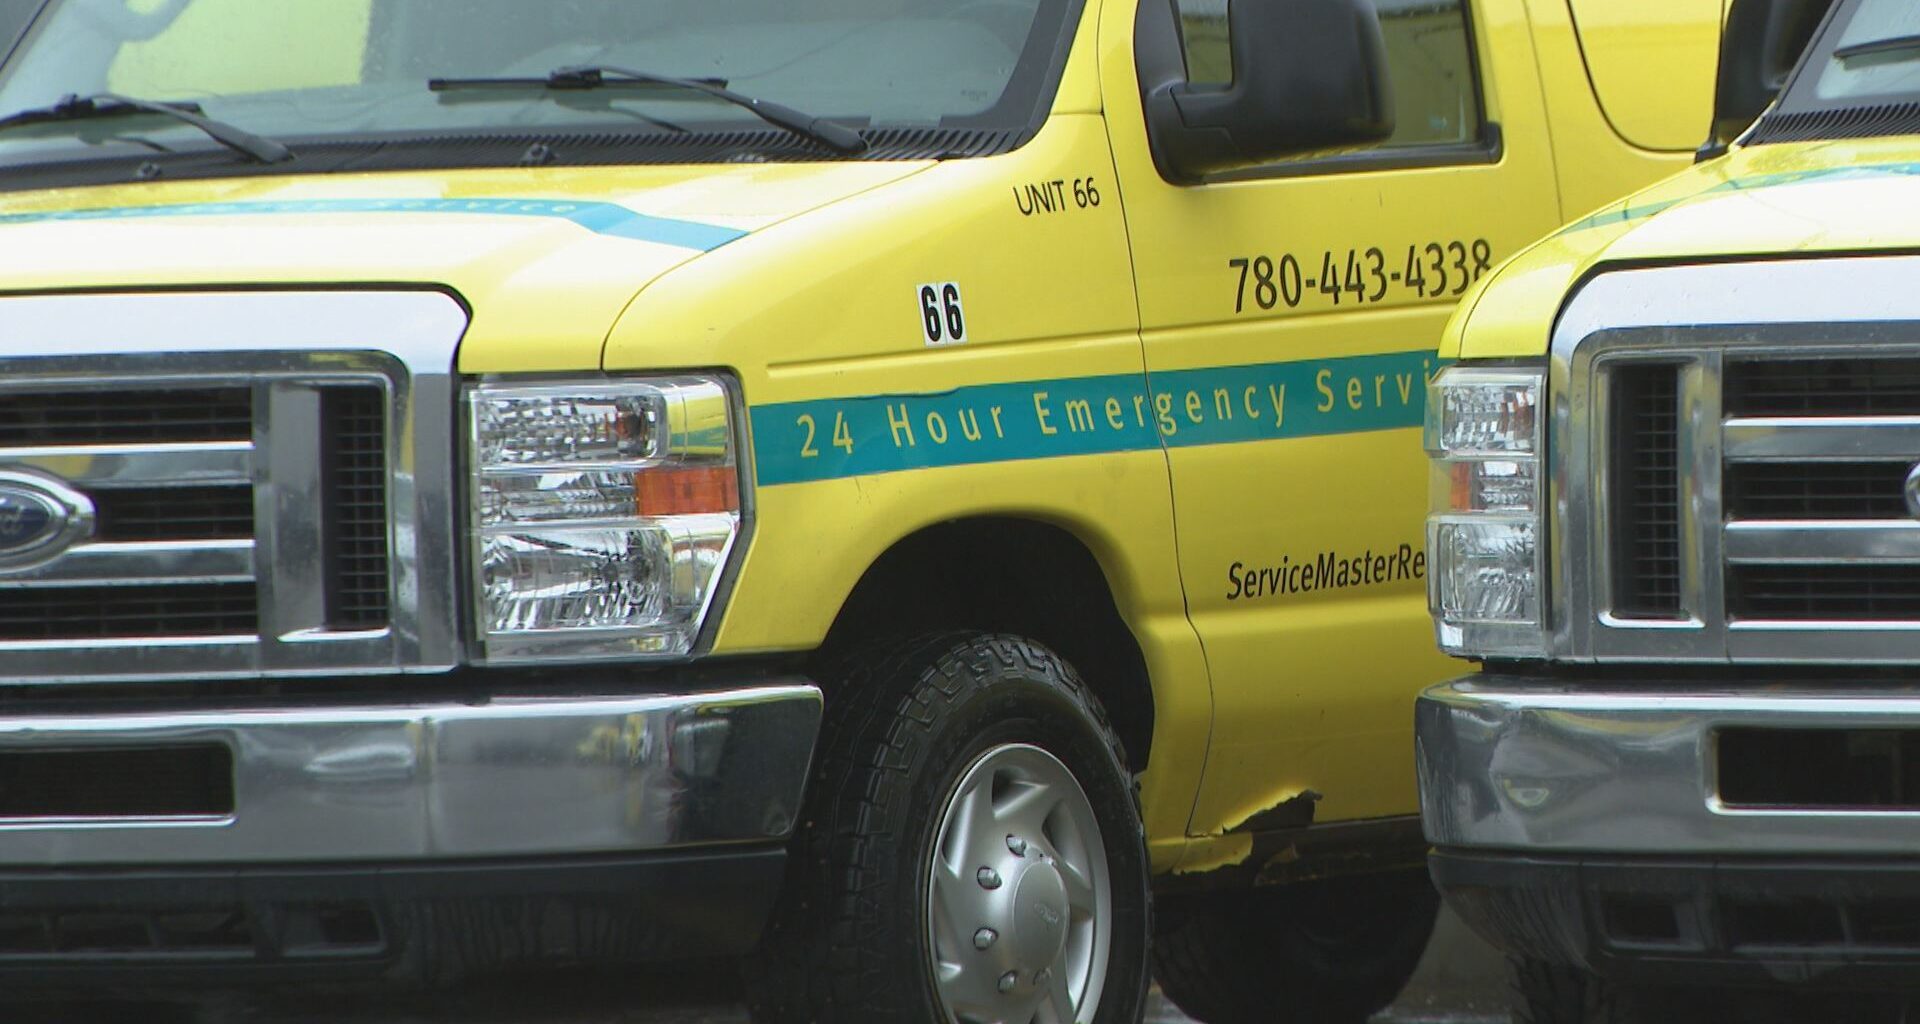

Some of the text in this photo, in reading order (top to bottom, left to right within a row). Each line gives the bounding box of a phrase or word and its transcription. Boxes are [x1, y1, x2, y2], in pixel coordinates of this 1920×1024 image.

[1012, 177, 1101, 216] UNIT 66
[1228, 238, 1492, 314] 780-443-4338
[920, 282, 963, 343] 66
[796, 410, 854, 457] 24
[886, 402, 1004, 448] Hour
[1033, 383, 1287, 436] Emergency
[1226, 543, 1426, 601] ServiceMasterRe
